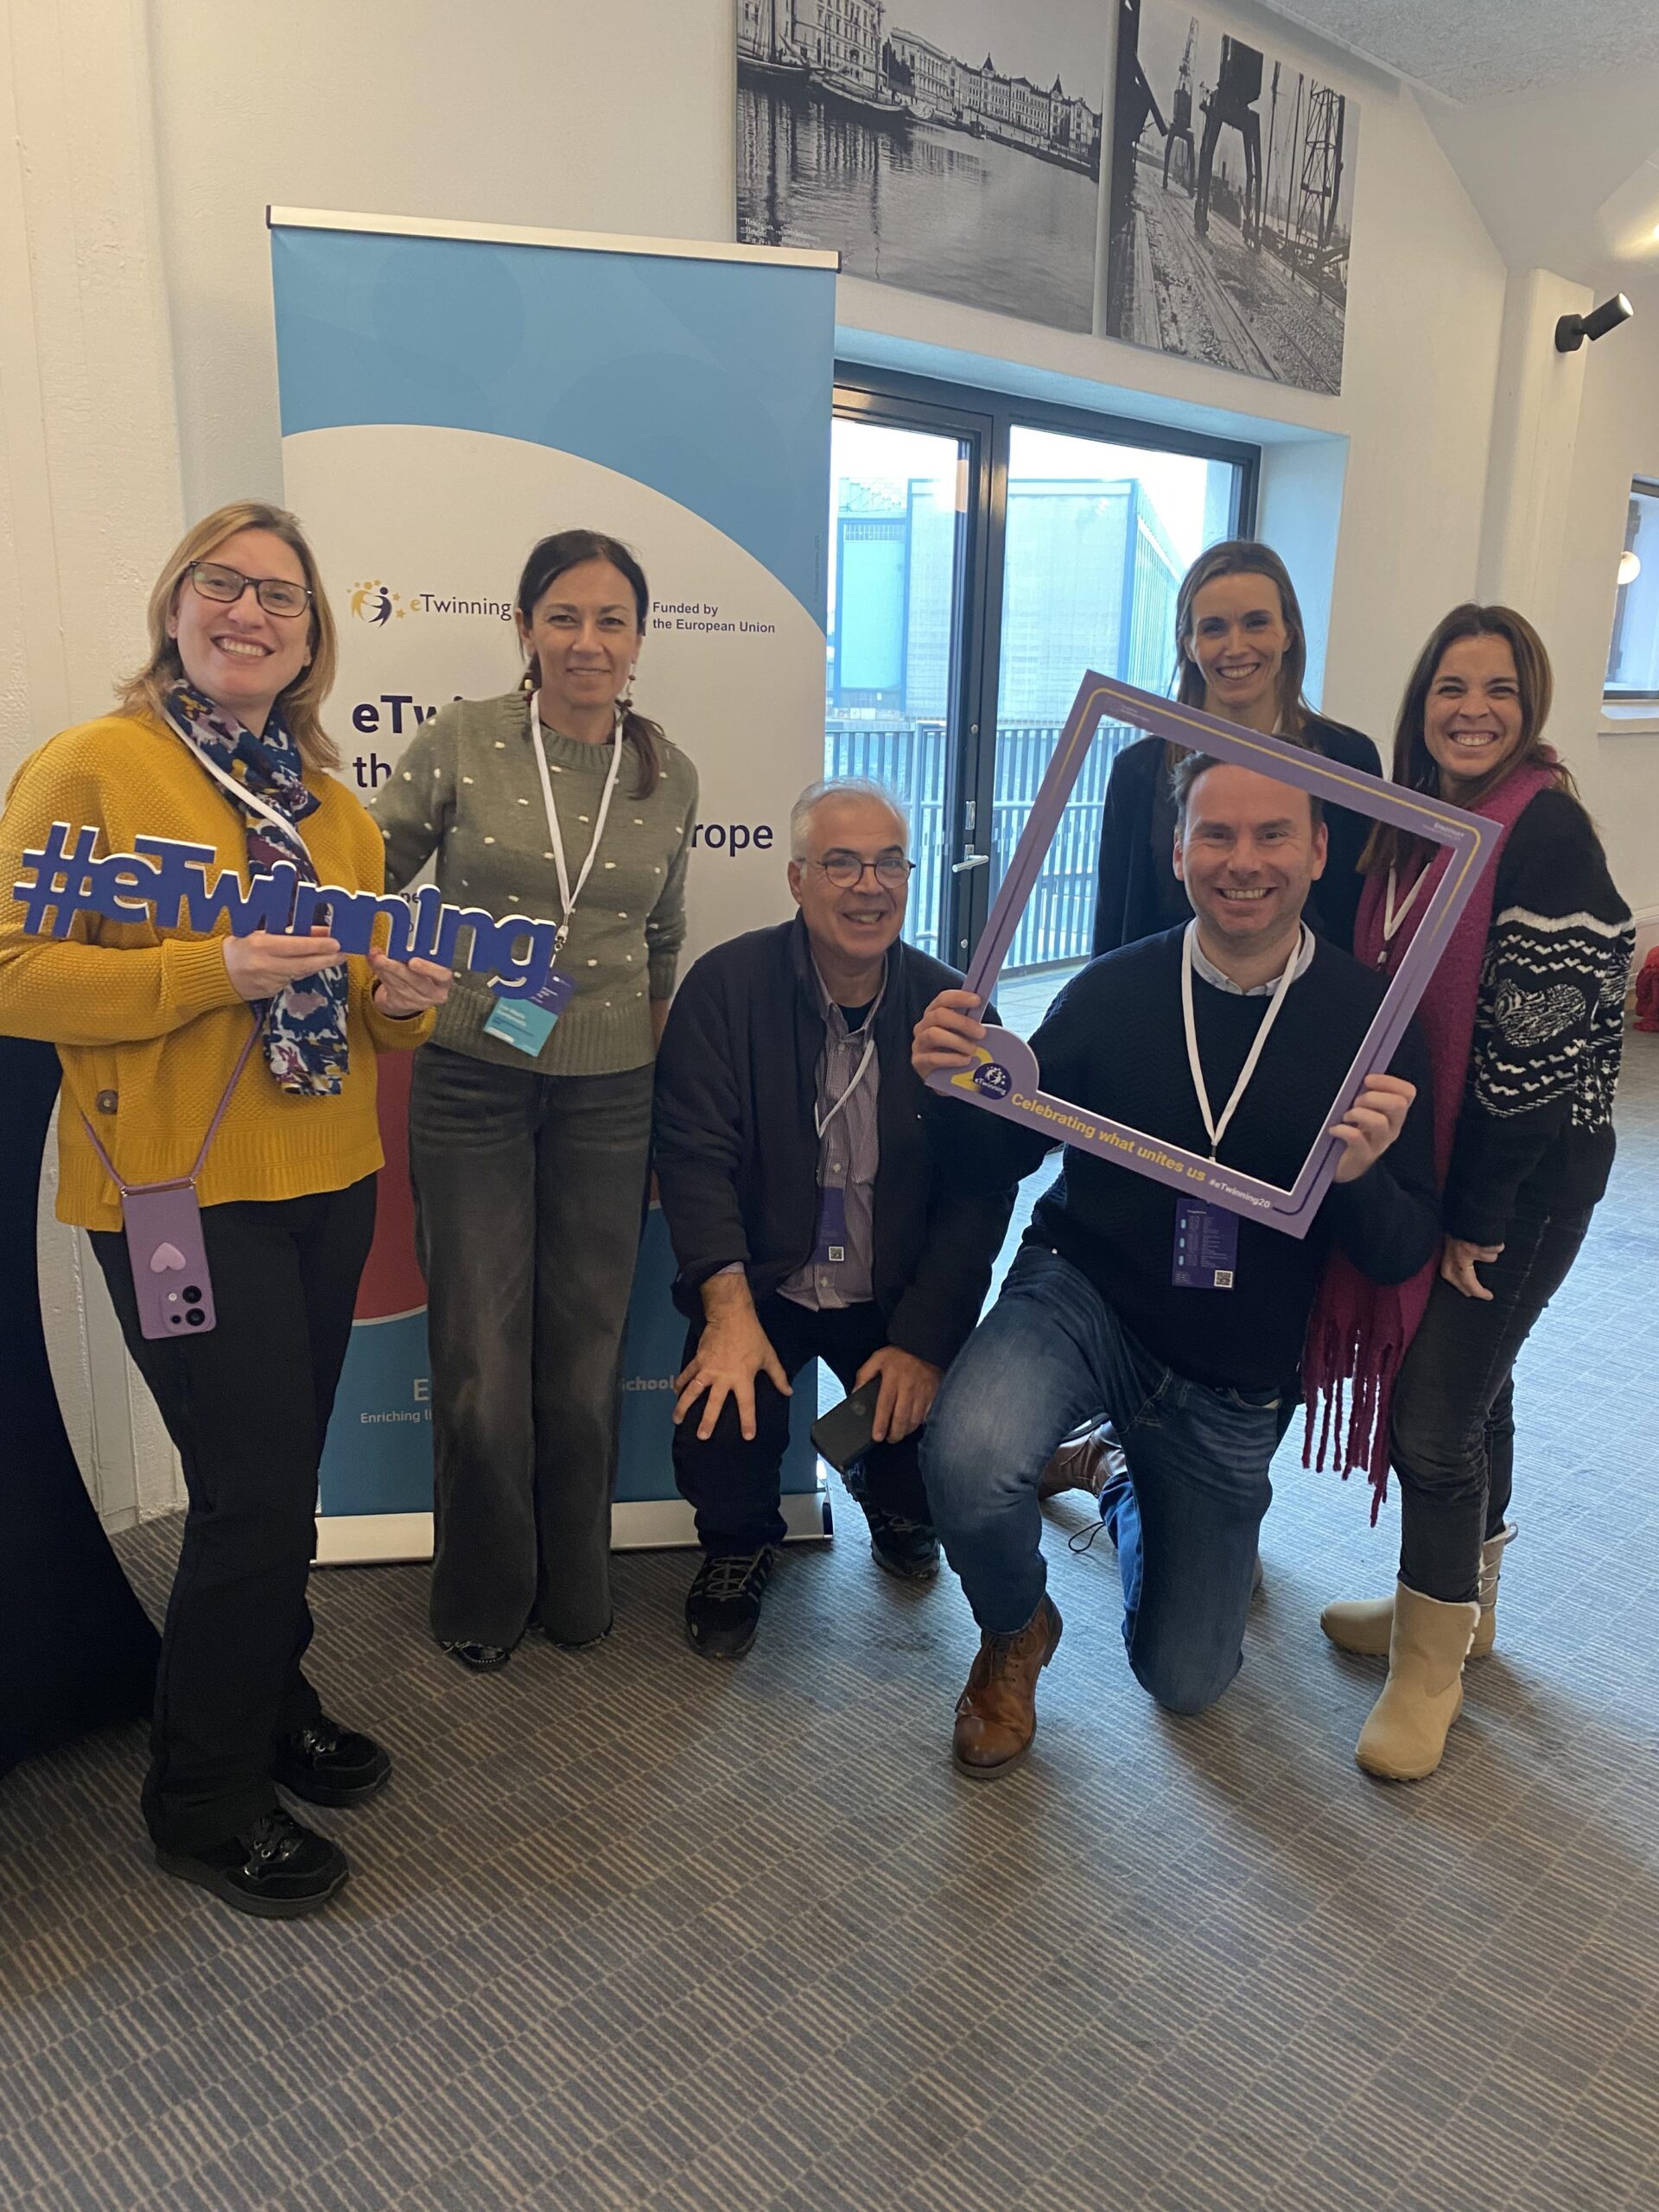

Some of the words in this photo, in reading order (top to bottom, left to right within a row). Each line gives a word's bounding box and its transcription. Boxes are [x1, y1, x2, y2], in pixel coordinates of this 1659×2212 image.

[409, 594, 512, 620] eTwinning
[652, 601, 700, 614] Funded
[703, 603, 719, 618] by
[652, 618, 672, 629] the
[676, 619, 735, 633] European
[739, 621, 776, 633] Union
[13, 821, 556, 999] #eTwinning
[1011, 1093, 1096, 1139] Celebrating
[1098, 1130, 1135, 1154] what
[1136, 1147, 1185, 1173] unites
[1186, 1166, 1207, 1182] us
[1209, 1179, 1271, 1209] #eTwinning20
[360, 1411, 421, 1423] Enriching
